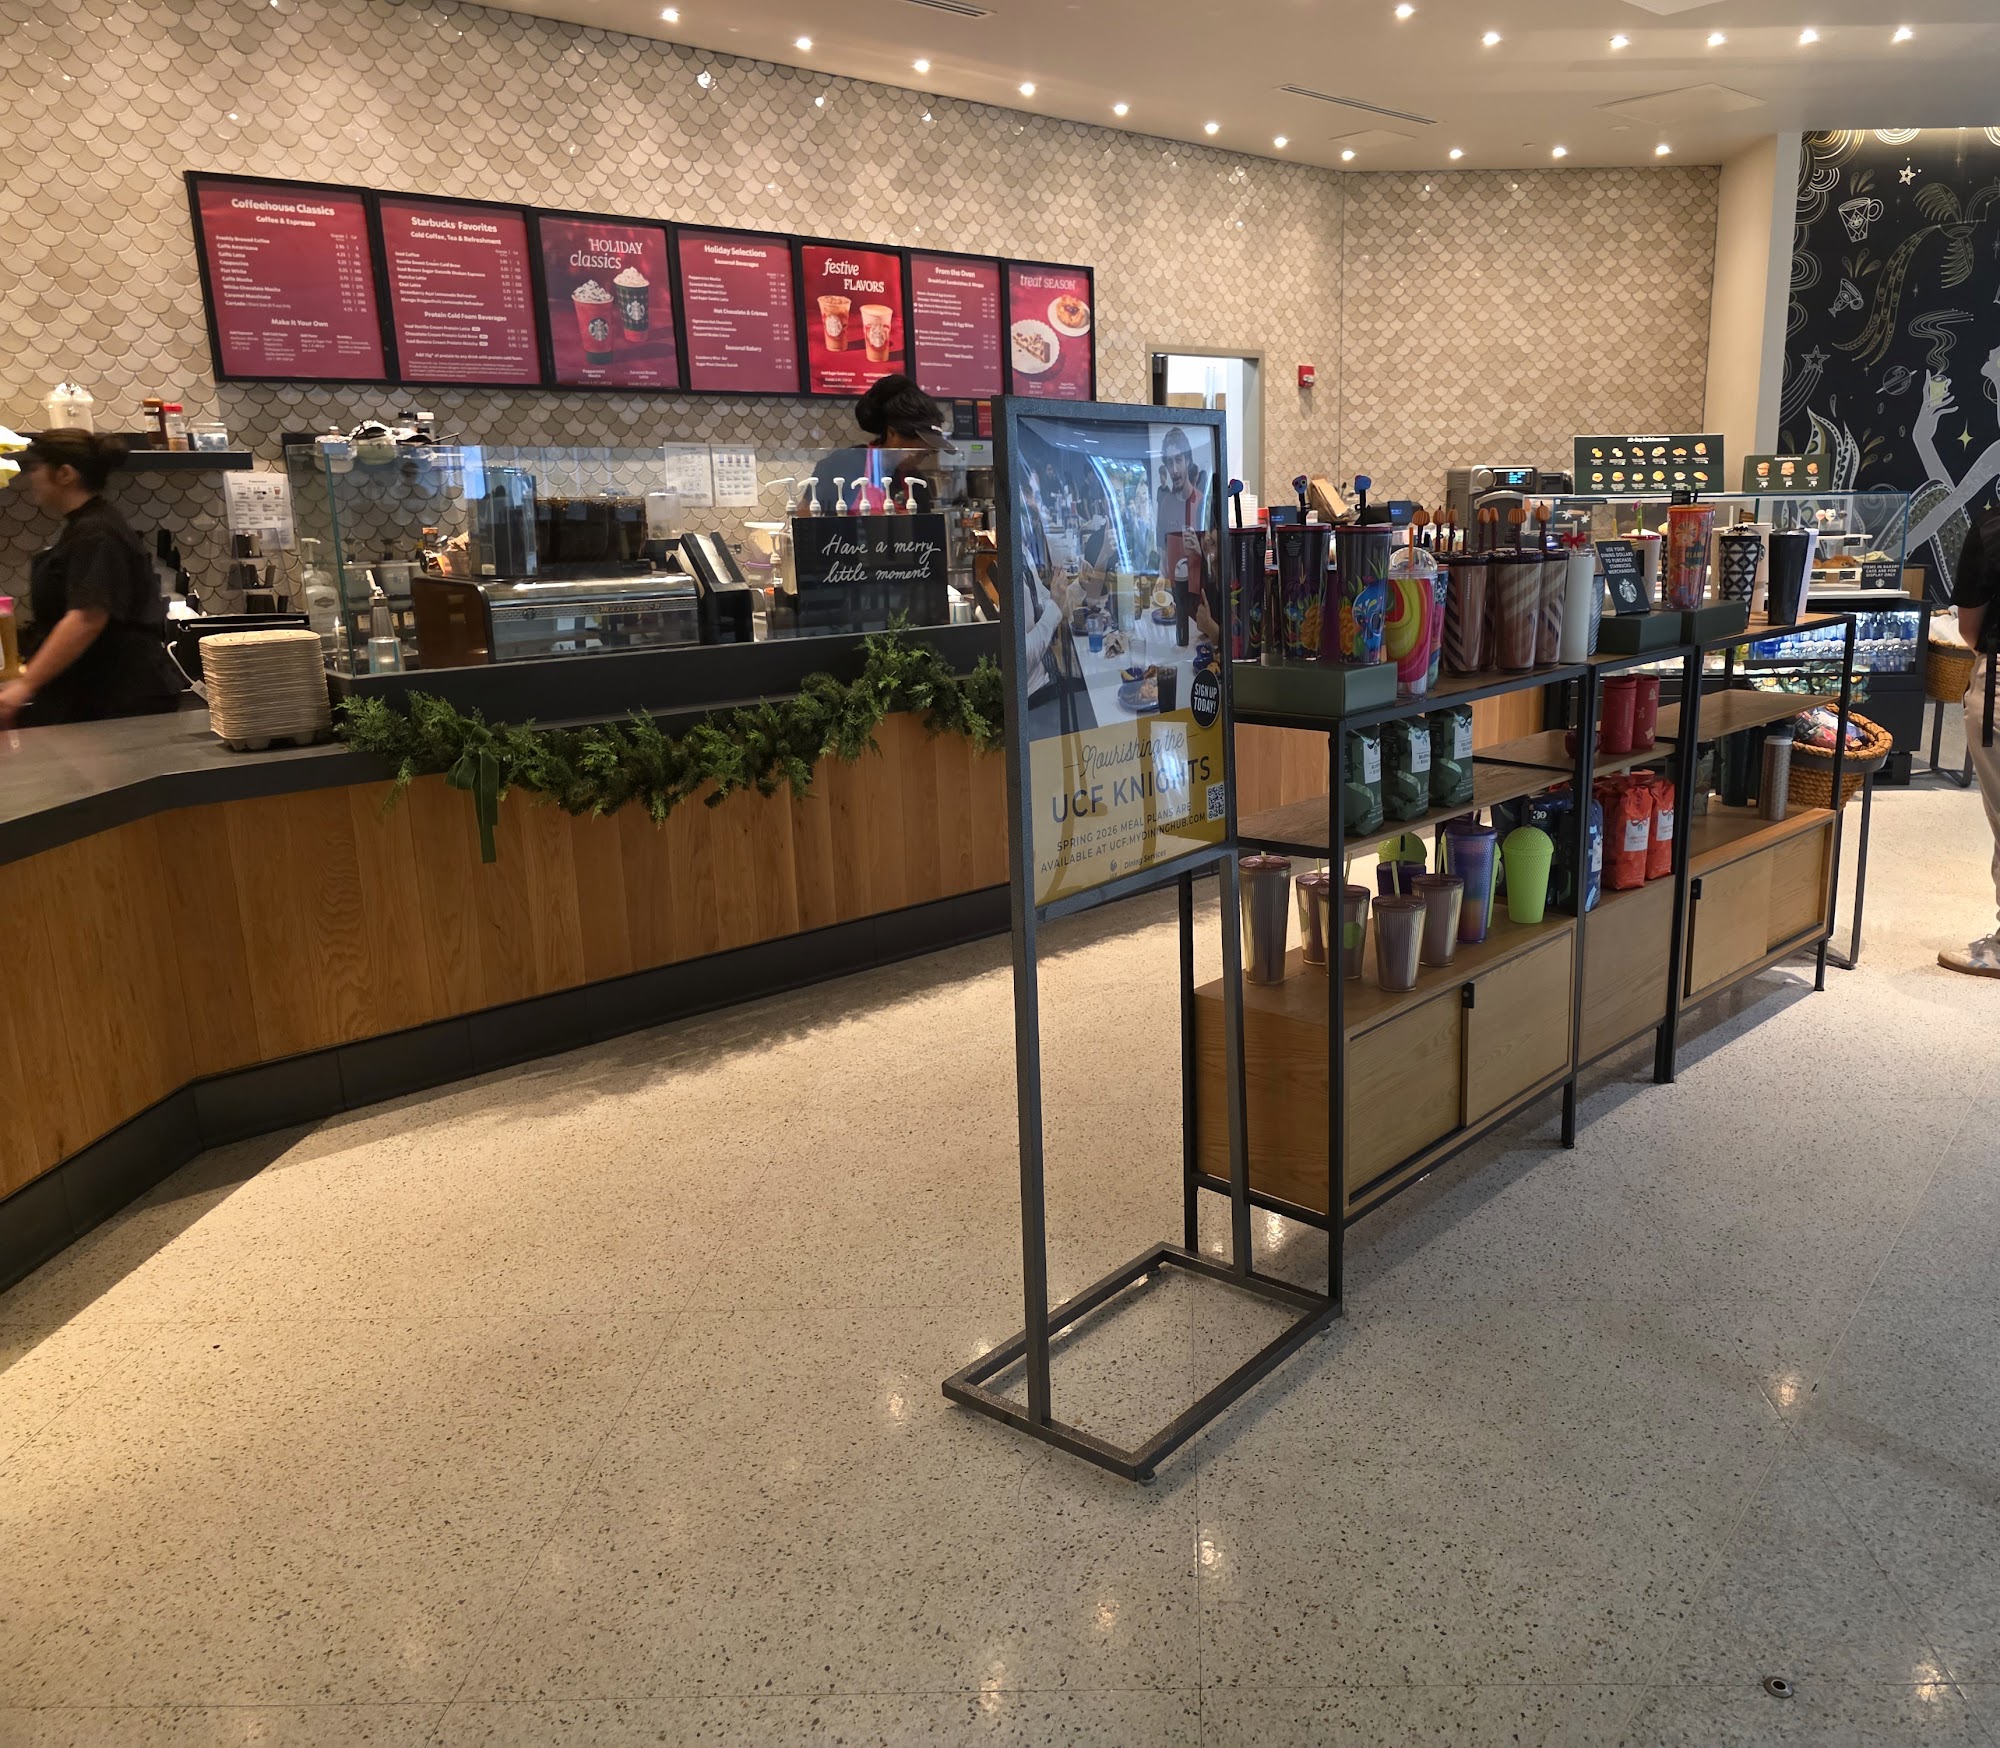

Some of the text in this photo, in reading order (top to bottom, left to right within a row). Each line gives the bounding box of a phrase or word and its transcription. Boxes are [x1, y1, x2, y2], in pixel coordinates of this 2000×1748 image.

[232, 198, 335, 216] Coffeehouse Classics
[256, 216, 278, 224] Coffee
[286, 219, 316, 228] Espresso
[411, 217, 498, 233] Starbucks Favorites
[425, 232, 446, 240] Coffee,
[464, 236, 501, 245] Refreshment
[588, 238, 642, 254] HOLIDAY
[704, 244, 766, 258] Holiday Selections
[570, 250, 622, 269] classics
[736, 260, 759, 268] Beverages
[822, 258, 859, 276] festive
[936, 267, 976, 278] From the Oven
[844, 278, 884, 293] FLAVORS
[1020, 274, 1076, 290] treat SEASON
[822, 534, 941, 565] Have a merry
[822, 560, 931, 584] little moment
[1194, 683, 1217, 699] SIGN UP
[1194, 697, 1216, 714] TODAY!
[1080, 728, 1185, 779] Nourishing the
[1052, 756, 1211, 823] UCF KNIGHTS
[1533, 810, 1547, 820] 30
[1056, 802, 1191, 852] SPRING 2026 MEAL PLANS ARE
[1041, 812, 1206, 873] AVAILABLE AT UCF.MYDININGHUB.COM
[1124, 850, 1167, 869] Dining Services
